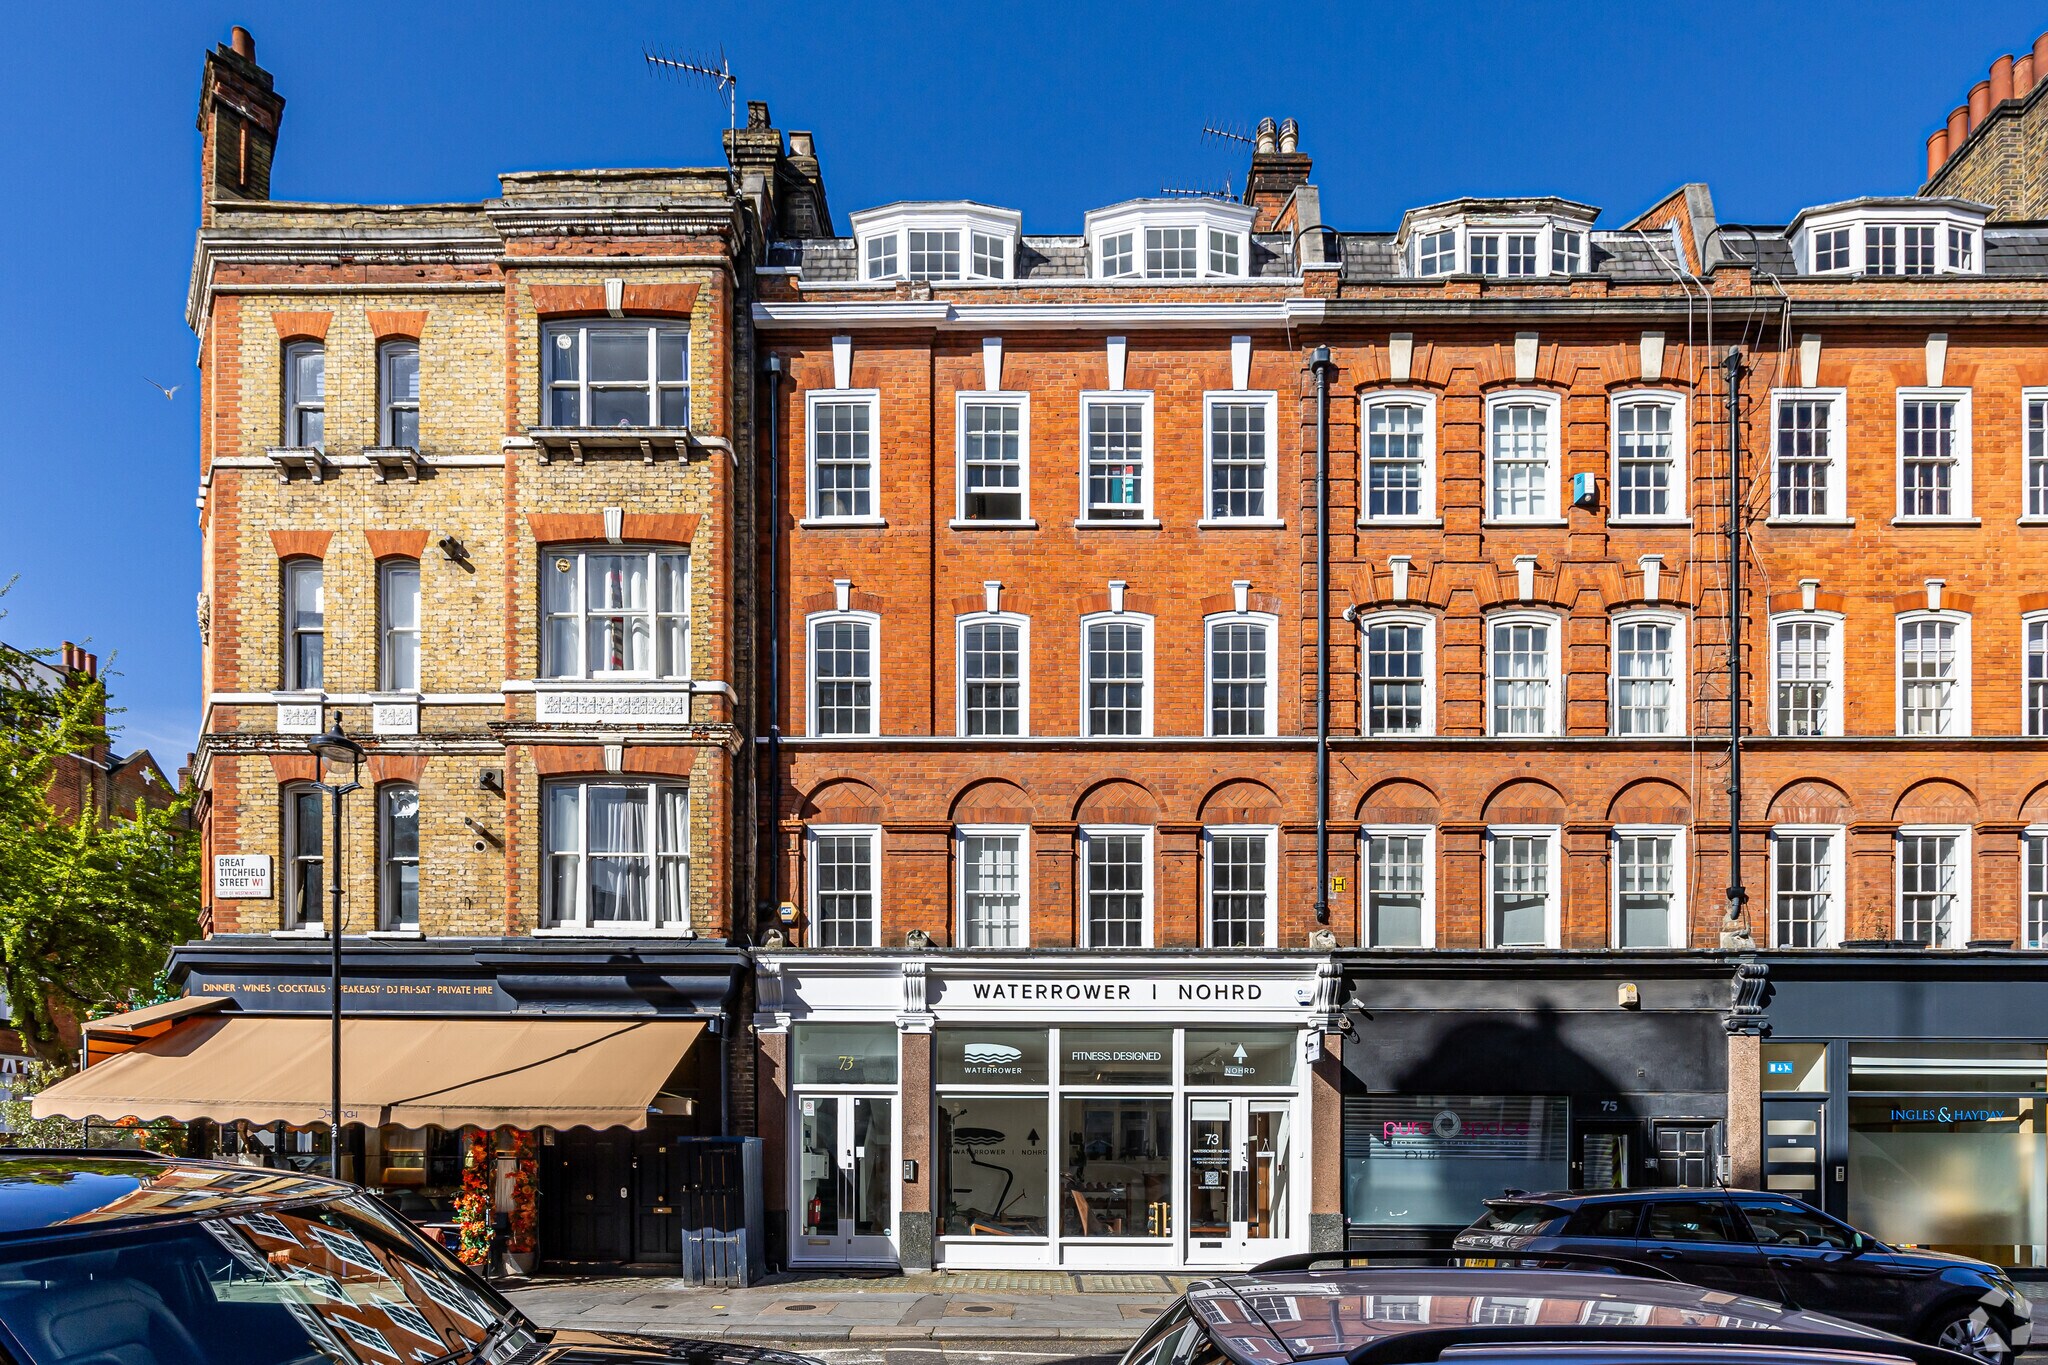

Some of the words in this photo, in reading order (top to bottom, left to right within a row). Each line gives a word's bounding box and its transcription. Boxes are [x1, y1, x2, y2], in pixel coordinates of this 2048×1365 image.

[219, 858, 245, 867] GREAT
[220, 868, 266, 877] TITCHFIELD
[219, 878, 249, 887] STREET
[252, 878, 264, 887] W1
[203, 984, 236, 992] DINNER
[243, 984, 271, 993] WINES
[278, 984, 326, 993] COCKTAILS
[386, 985, 398, 994] DJ
[400, 985, 432, 994] FRI-SAT
[437, 986, 471, 994] PRIVATE
[474, 986, 493, 994] HIRE
[973, 984, 1131, 999] WATERROWER
[1179, 984, 1262, 1000] NOHRD
[1072, 1051, 1112, 1061] FITNESS.
[1114, 1051, 1161, 1061] DESIGNED
[838, 1056, 854, 1071] 73
[1601, 1101, 1618, 1112] 75
[1890, 1110, 1935, 1121] INGLES
[1937, 1106, 1954, 1123] &
[1954, 1110, 2005, 1121] HAYDAY
[1383, 1121, 1432, 1140] pure
[1205, 1134, 1219, 1145] 73
